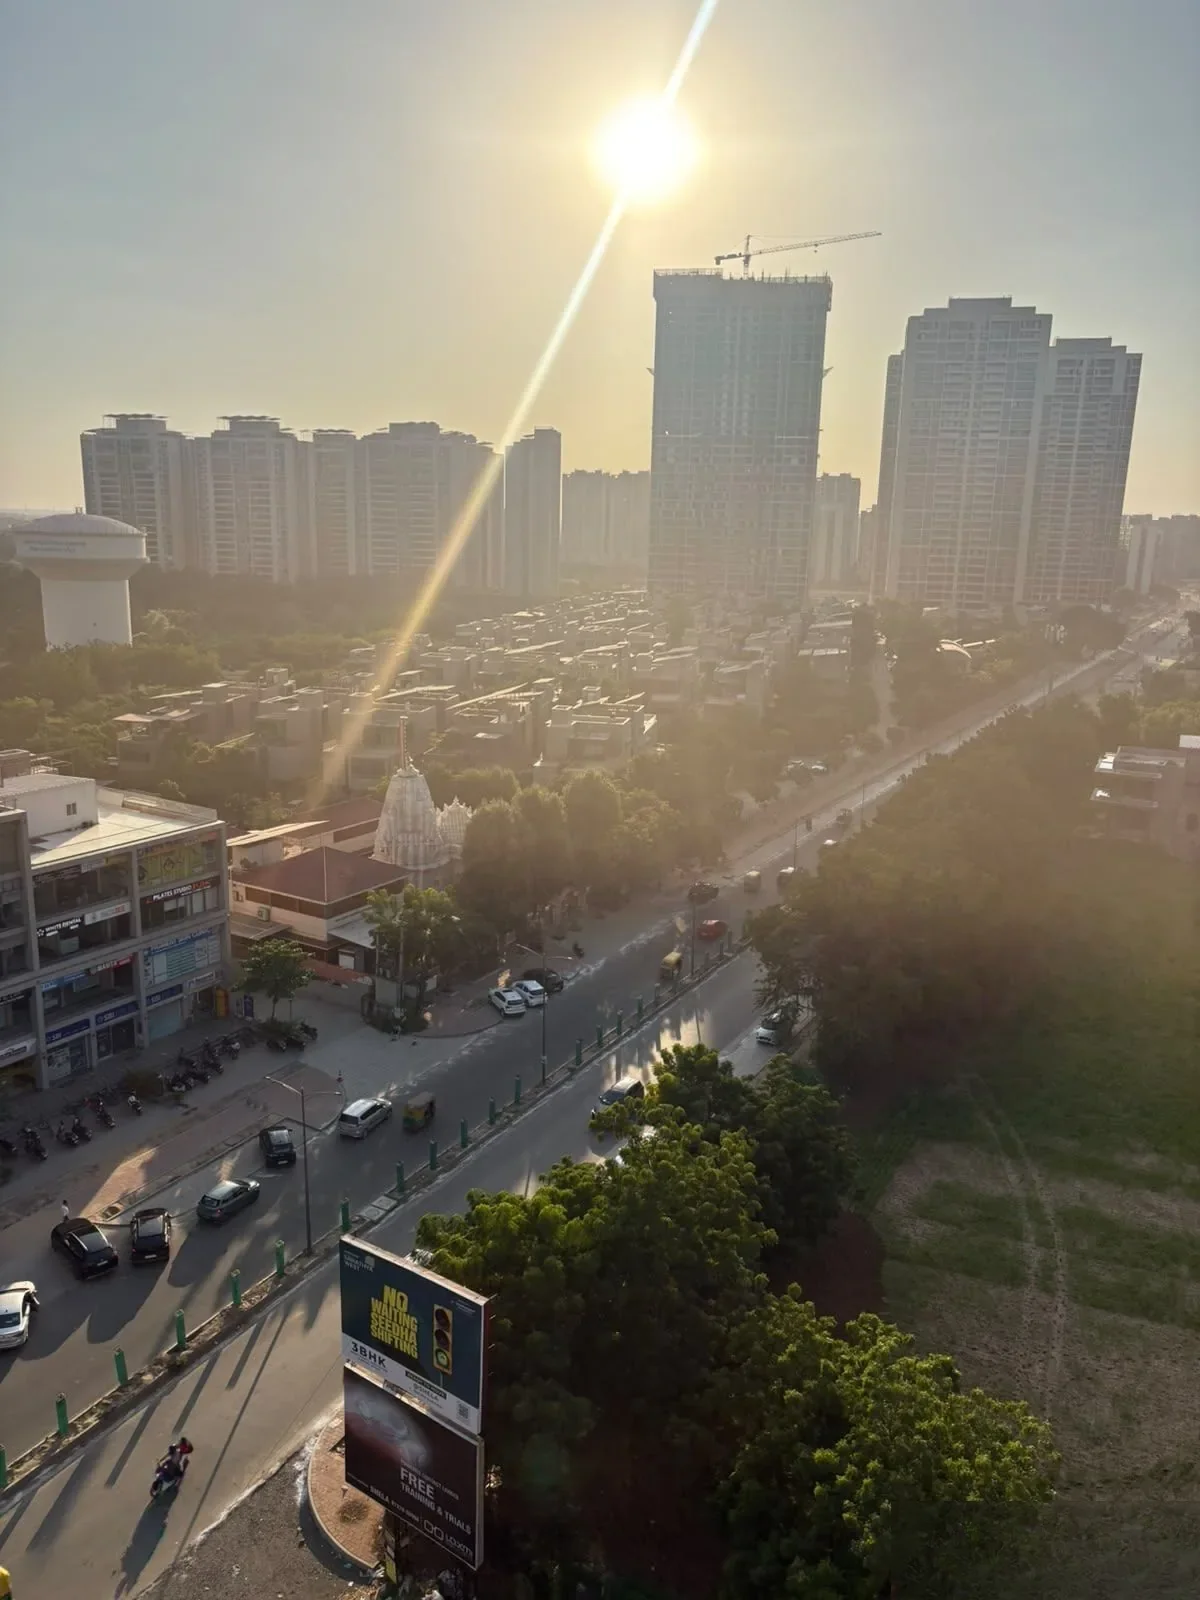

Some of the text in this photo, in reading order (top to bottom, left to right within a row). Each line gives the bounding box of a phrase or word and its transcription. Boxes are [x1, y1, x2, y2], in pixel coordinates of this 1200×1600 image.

[371, 1297, 418, 1332] WAITING
[384, 1284, 408, 1312] NO
[371, 1312, 417, 1346] SEEDHA
[371, 1324, 418, 1359] SHIFTING
[351, 1341, 387, 1368] 3BHK
[400, 1467, 434, 1500] FREE
[400, 1481, 435, 1511] TRAINING
[436, 1506, 443, 1517] &
[444, 1511, 471, 1535] TRIALS
